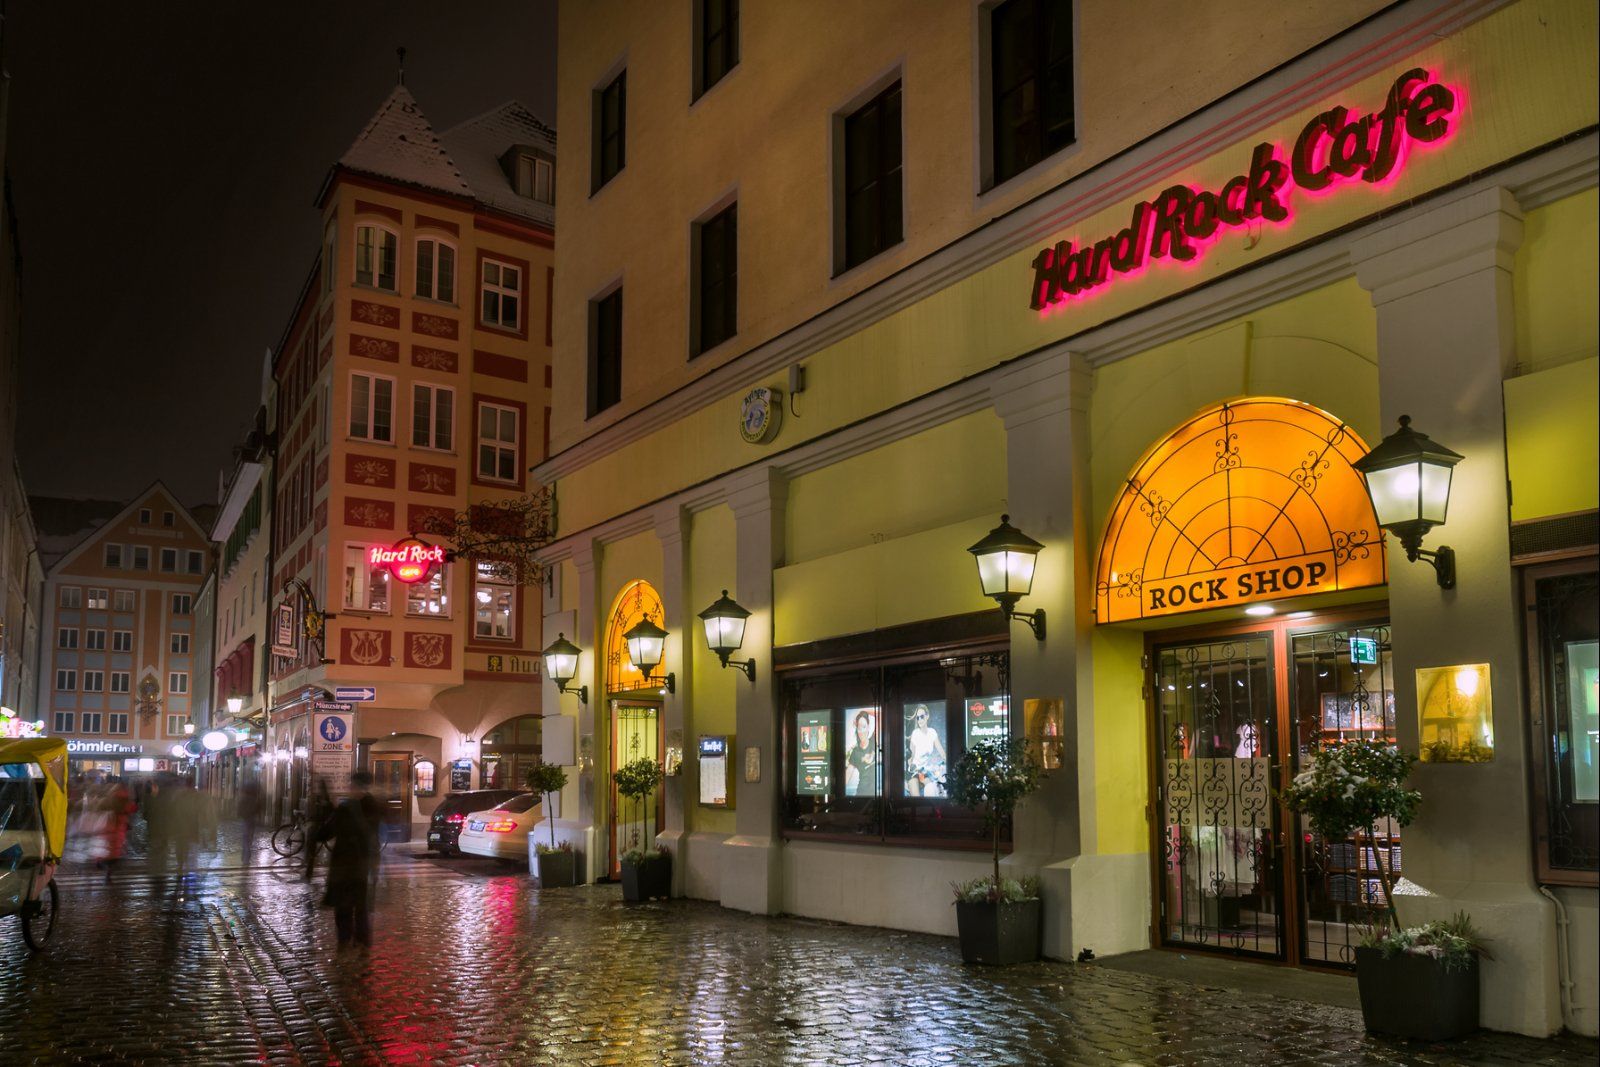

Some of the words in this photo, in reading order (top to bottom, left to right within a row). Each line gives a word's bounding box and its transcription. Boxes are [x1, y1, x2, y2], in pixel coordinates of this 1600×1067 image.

[1030, 200, 1155, 311] Hard
[1150, 142, 1289, 262] Rock
[1291, 67, 1456, 191] Cafe
[370, 546, 409, 563] Hard
[409, 544, 443, 563] Rock
[1149, 577, 1228, 610] ROCK
[1237, 561, 1327, 598] SHOP
[67, 740, 119, 752] öhmler
